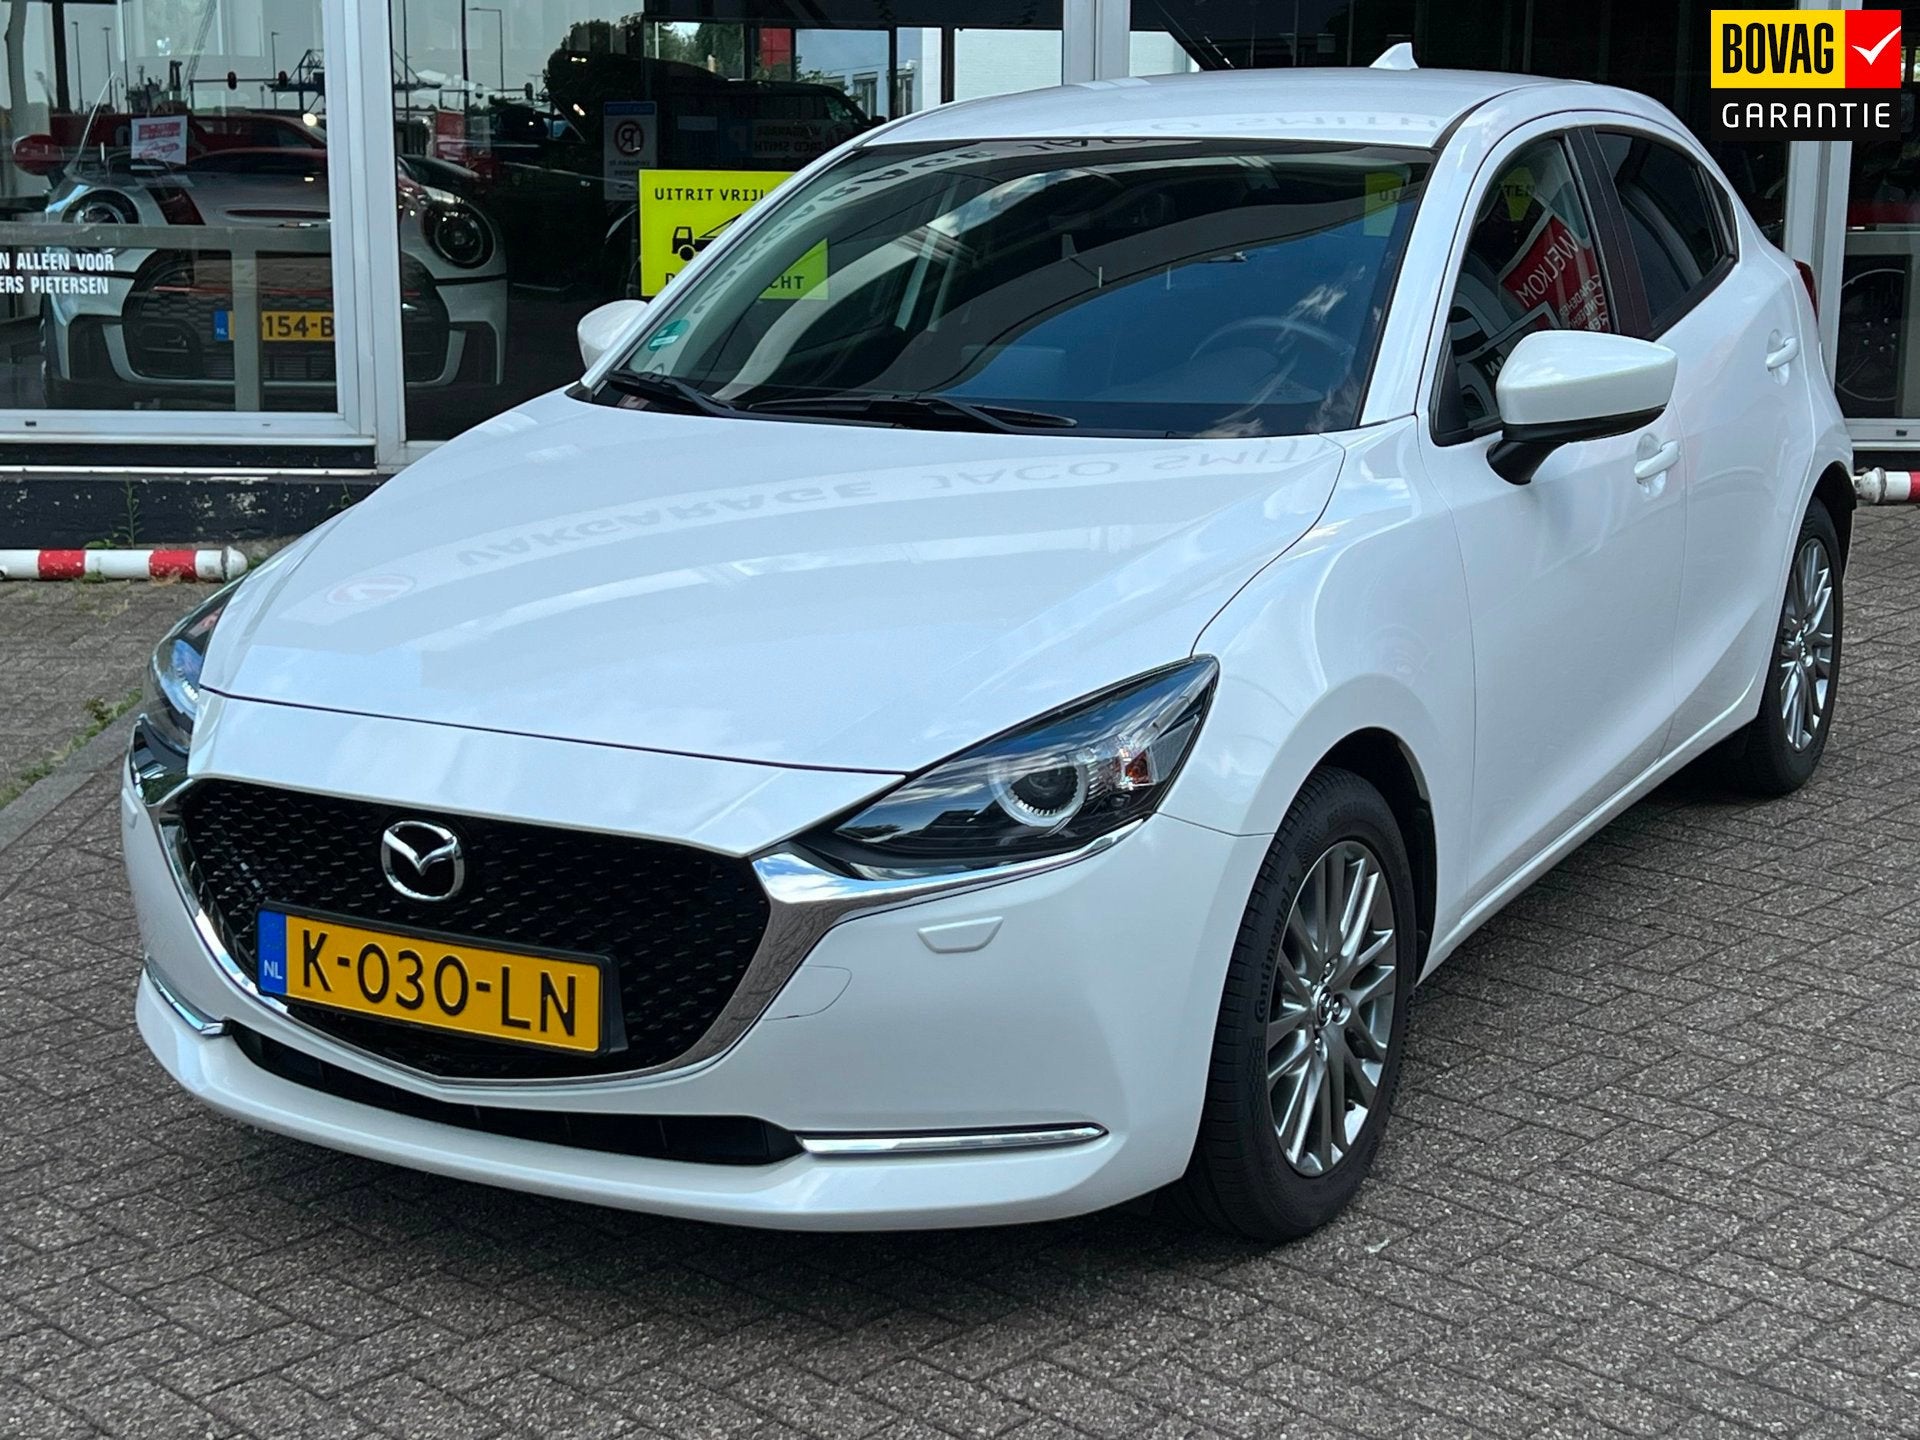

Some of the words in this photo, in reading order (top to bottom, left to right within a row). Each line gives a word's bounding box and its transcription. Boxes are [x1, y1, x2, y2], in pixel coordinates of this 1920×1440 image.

[654, 187, 714, 200] UITRIT
[16, 252, 71, 271] ALLEEN
[75, 253, 115, 271] VOOR
[30, 276, 109, 295] PIETERSEN
[264, 960, 283, 980] NL
[302, 929, 577, 1037] K-030-LN
